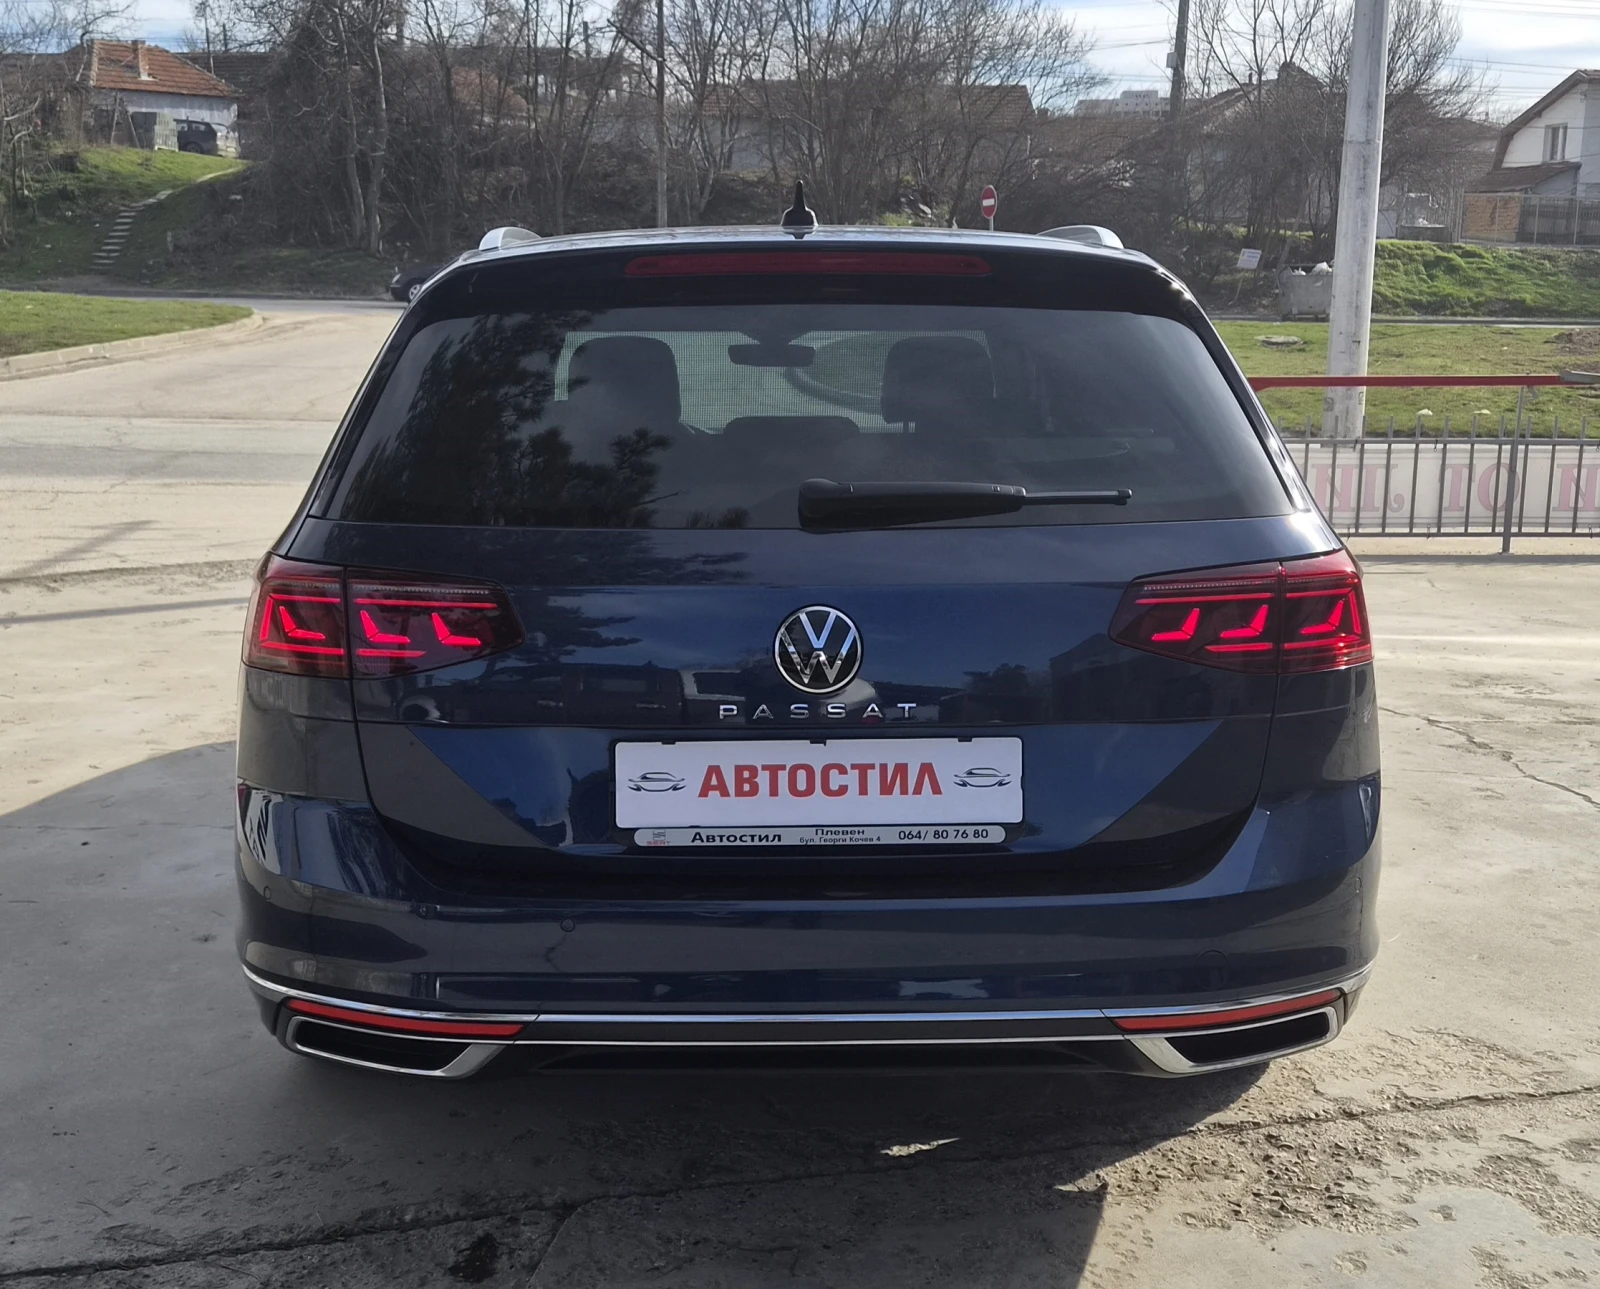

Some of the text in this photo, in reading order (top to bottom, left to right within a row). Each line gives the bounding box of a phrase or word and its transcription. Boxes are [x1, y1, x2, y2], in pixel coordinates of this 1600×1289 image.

[719, 702, 917, 720] PASSAT
[697, 762, 943, 798] АВТОСТИЛ
[690, 831, 782, 843] Автостил
[815, 828, 865, 836] Плевен
[898, 828, 989, 841] 064/ 80 76 80
[799, 837, 816, 846] бул.
[819, 837, 847, 845] Георги
